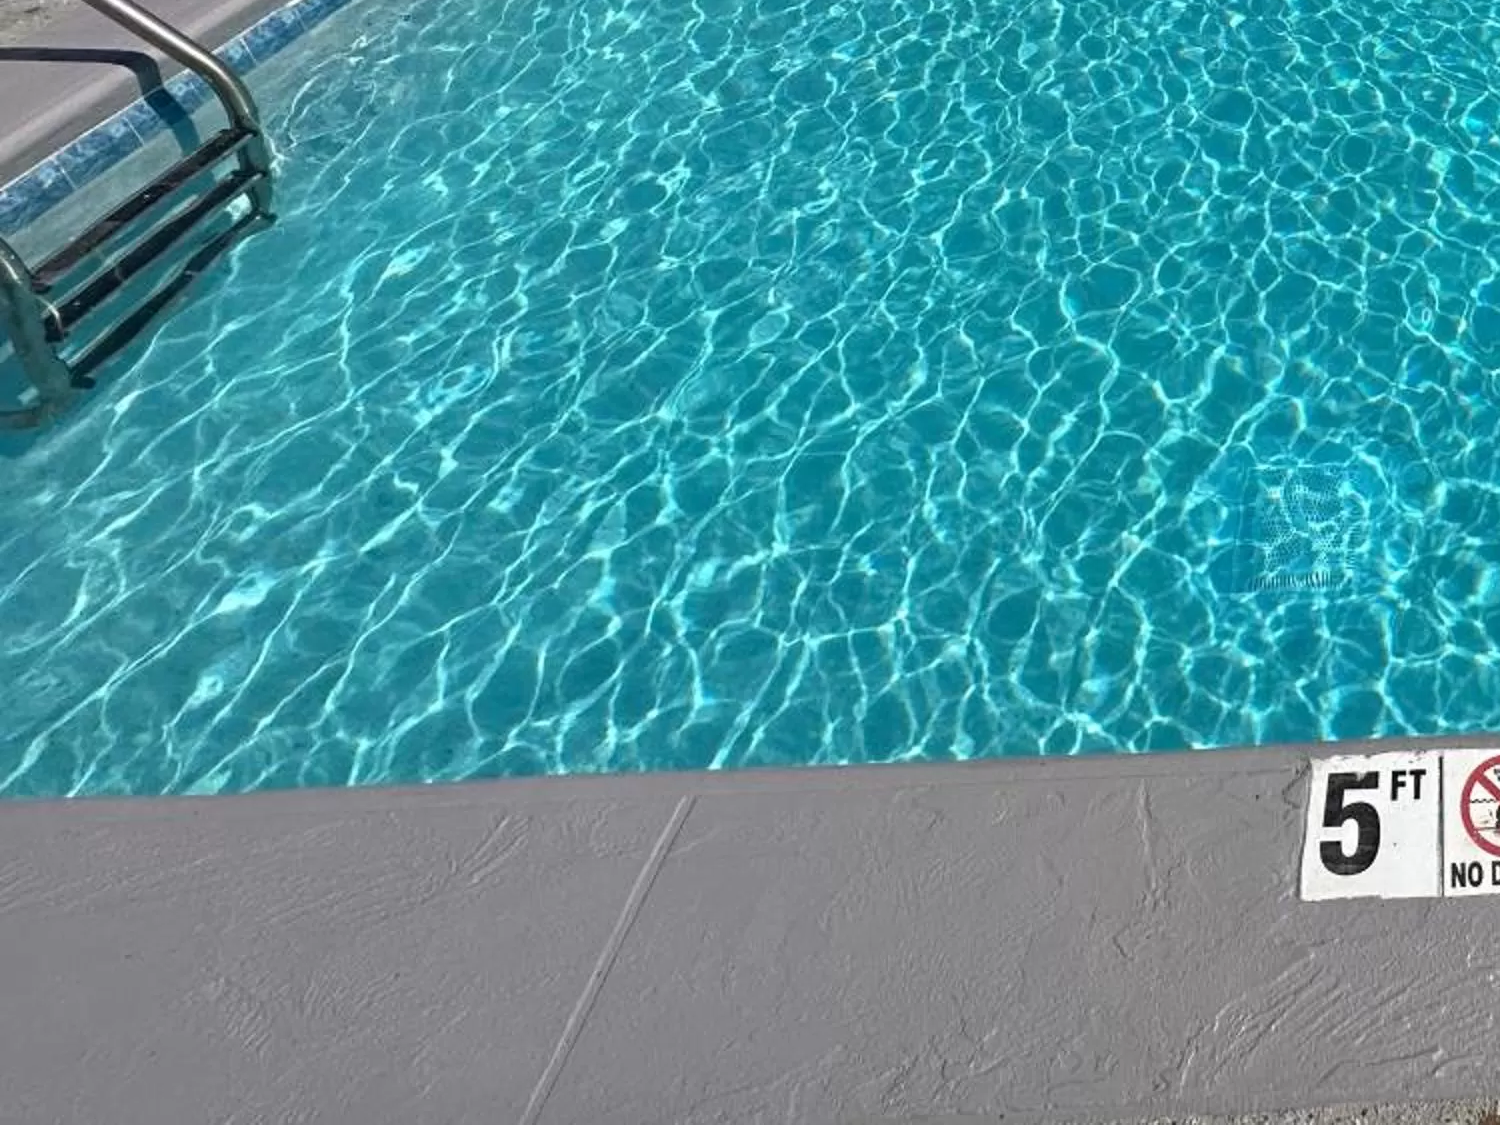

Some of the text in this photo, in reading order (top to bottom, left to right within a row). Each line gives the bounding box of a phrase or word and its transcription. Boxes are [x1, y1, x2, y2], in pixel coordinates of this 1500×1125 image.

[1319, 768, 1427, 876] 5 FT
[1450, 860, 1484, 888] NO
